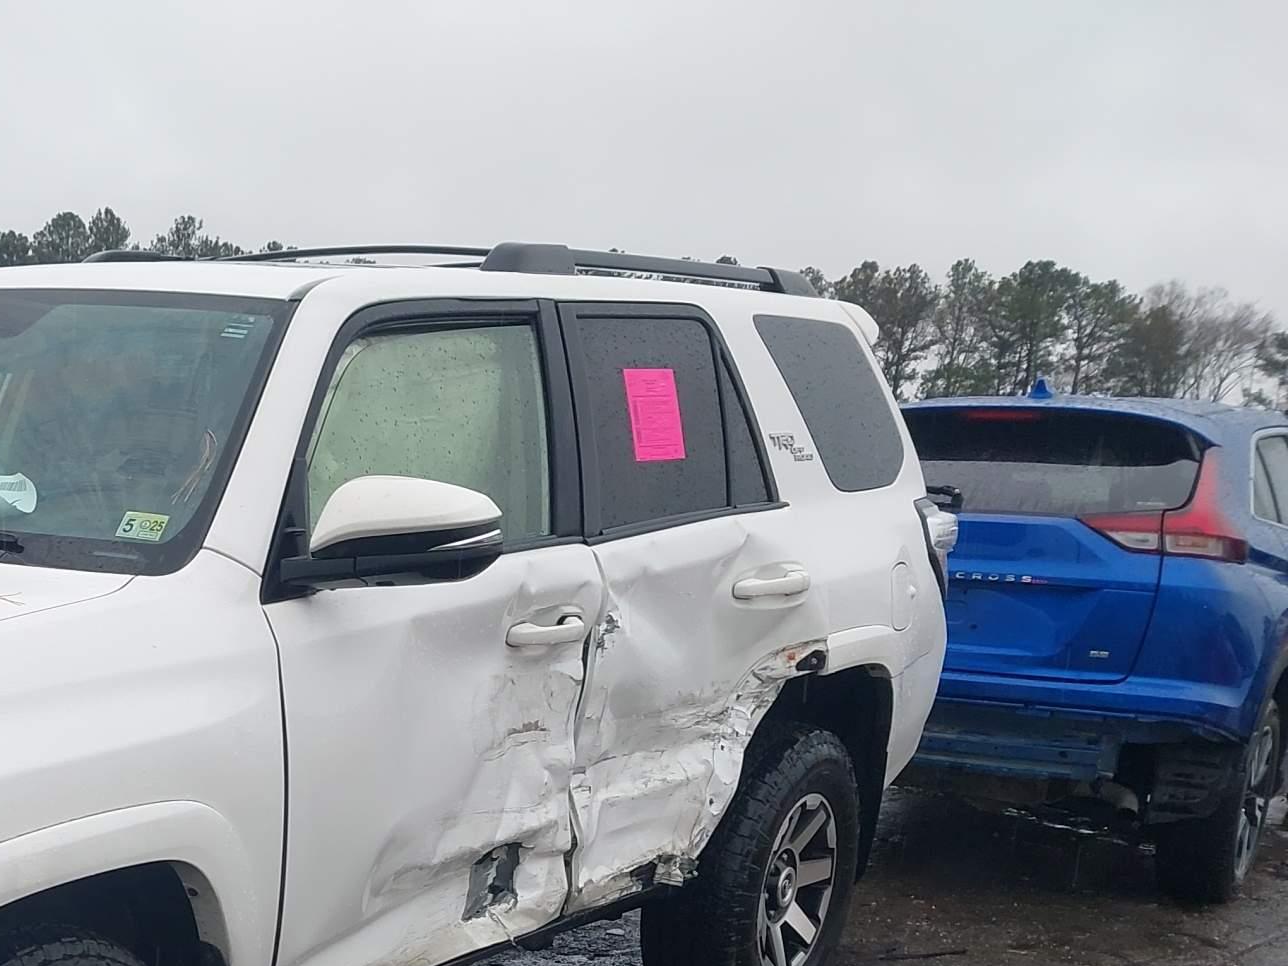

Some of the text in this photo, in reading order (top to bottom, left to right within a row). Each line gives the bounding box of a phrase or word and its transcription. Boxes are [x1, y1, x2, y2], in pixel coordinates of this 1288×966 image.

[122, 518, 165, 533] 5 25
[954, 571, 1033, 583] CROSS
